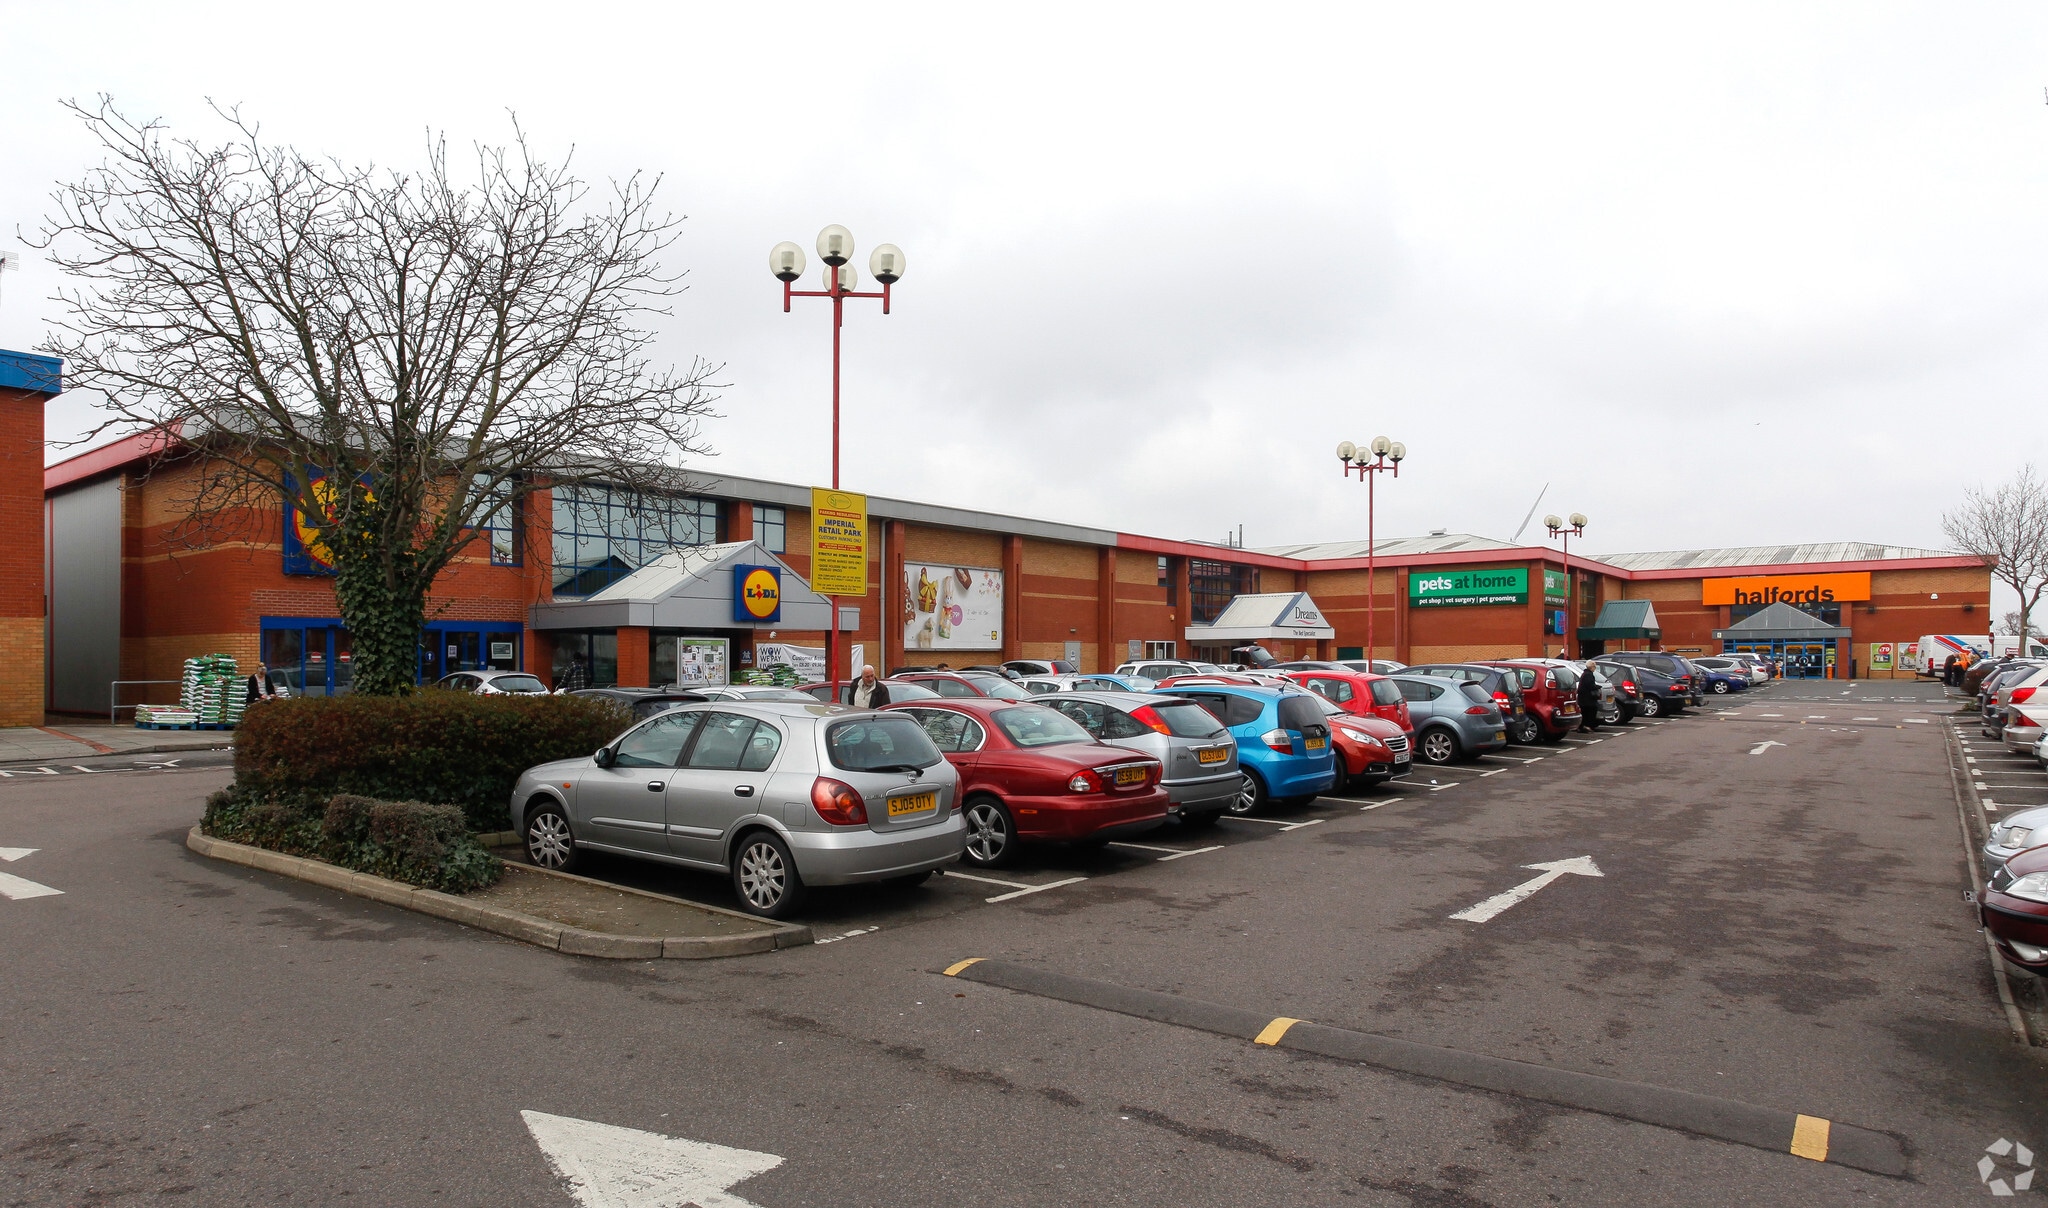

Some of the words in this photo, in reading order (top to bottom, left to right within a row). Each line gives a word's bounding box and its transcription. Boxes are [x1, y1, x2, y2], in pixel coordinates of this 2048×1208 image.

[824, 518, 856, 529] IMPERIAL
[818, 526, 841, 535] RETAIL
[843, 529, 862, 537] PARK
[1418, 576, 1453, 595] pets
[1454, 575, 1470, 590] at
[1472, 573, 1517, 589] home
[746, 584, 778, 600] LIDL
[1734, 585, 1835, 605] halfords
[1428, 597, 1442, 605] shop
[1454, 596, 1476, 604] surgery
[1479, 596, 1489, 604] pet
[1489, 595, 1517, 603] grooming
[1295, 606, 1318, 620] Dreams
[760, 647, 782, 656] WOW
[891, 797, 915, 812] SJ05
